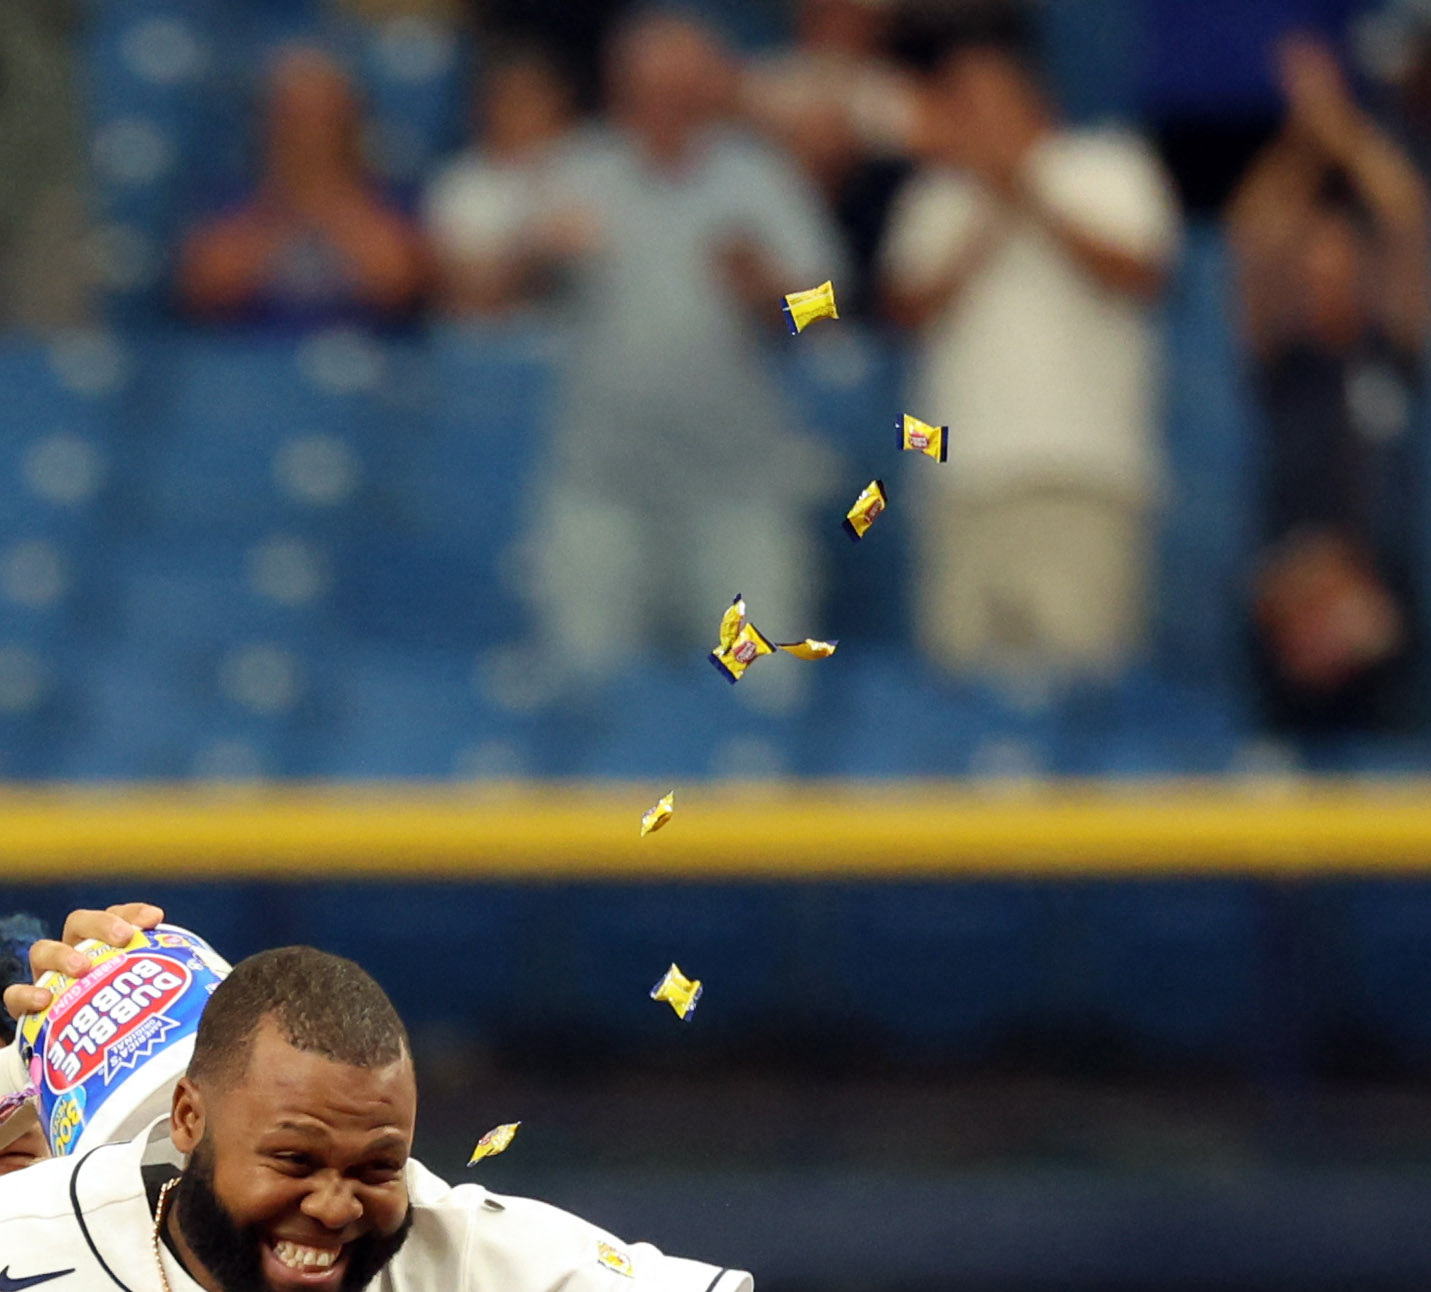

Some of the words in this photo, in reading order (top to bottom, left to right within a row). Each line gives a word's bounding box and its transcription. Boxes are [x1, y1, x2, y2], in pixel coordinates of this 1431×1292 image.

[47, 958, 164, 1071] BUBBLE
[54, 987, 82, 1015] GUM
[55, 970, 183, 1081] DUBBLE
[111, 1019, 162, 1068] AMERICA'S
[112, 1018, 157, 1053] ORIGINAL
